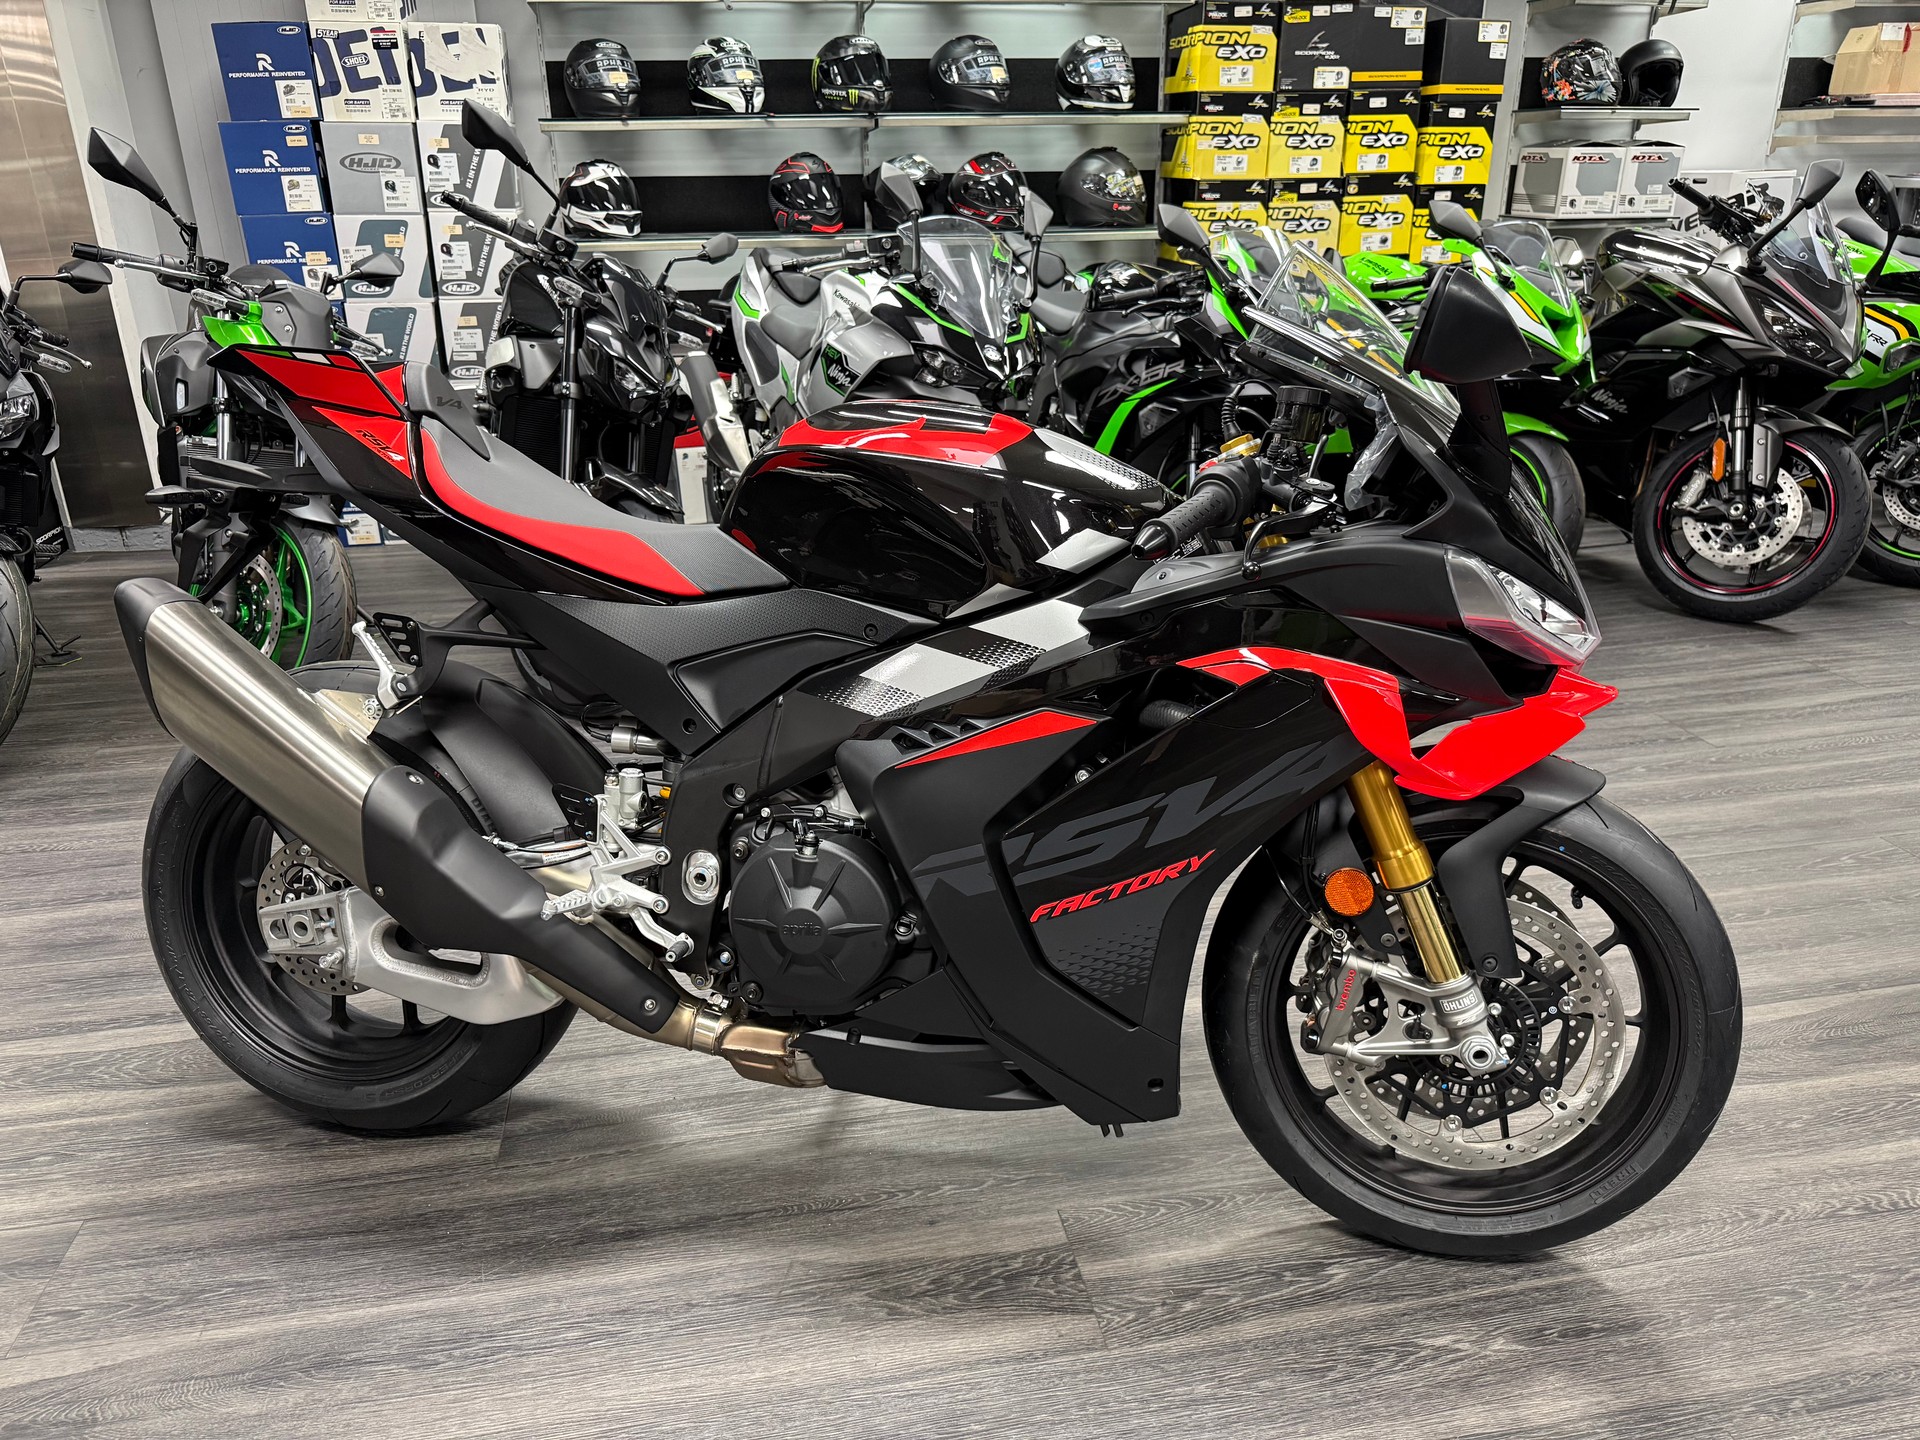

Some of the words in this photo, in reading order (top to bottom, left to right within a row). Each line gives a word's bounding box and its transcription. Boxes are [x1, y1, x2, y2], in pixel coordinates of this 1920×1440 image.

[1168, 32, 1250, 50] SCORPION
[596, 59, 622, 67] RPHA
[722, 56, 747, 65] RPHA
[977, 55, 999, 64] RPHA
[1102, 56, 1125, 65] RPHA
[348, 157, 393, 169] HJC
[447, 284, 475, 292] HJC
[406, 313, 415, 332] WORLD
[825, 345, 841, 360] HEV
[827, 363, 852, 387] Ninja
[436, 396, 463, 409] V4
[1591, 388, 1628, 414] Ninja
[355, 429, 406, 461] RSV4
[911, 738, 1341, 896] RSV4
[1029, 848, 1217, 924] FACTORY
[783, 922, 822, 936] aprilia
[1335, 969, 1357, 1011] brembo
[1442, 993, 1476, 1011] ÖHLINS
